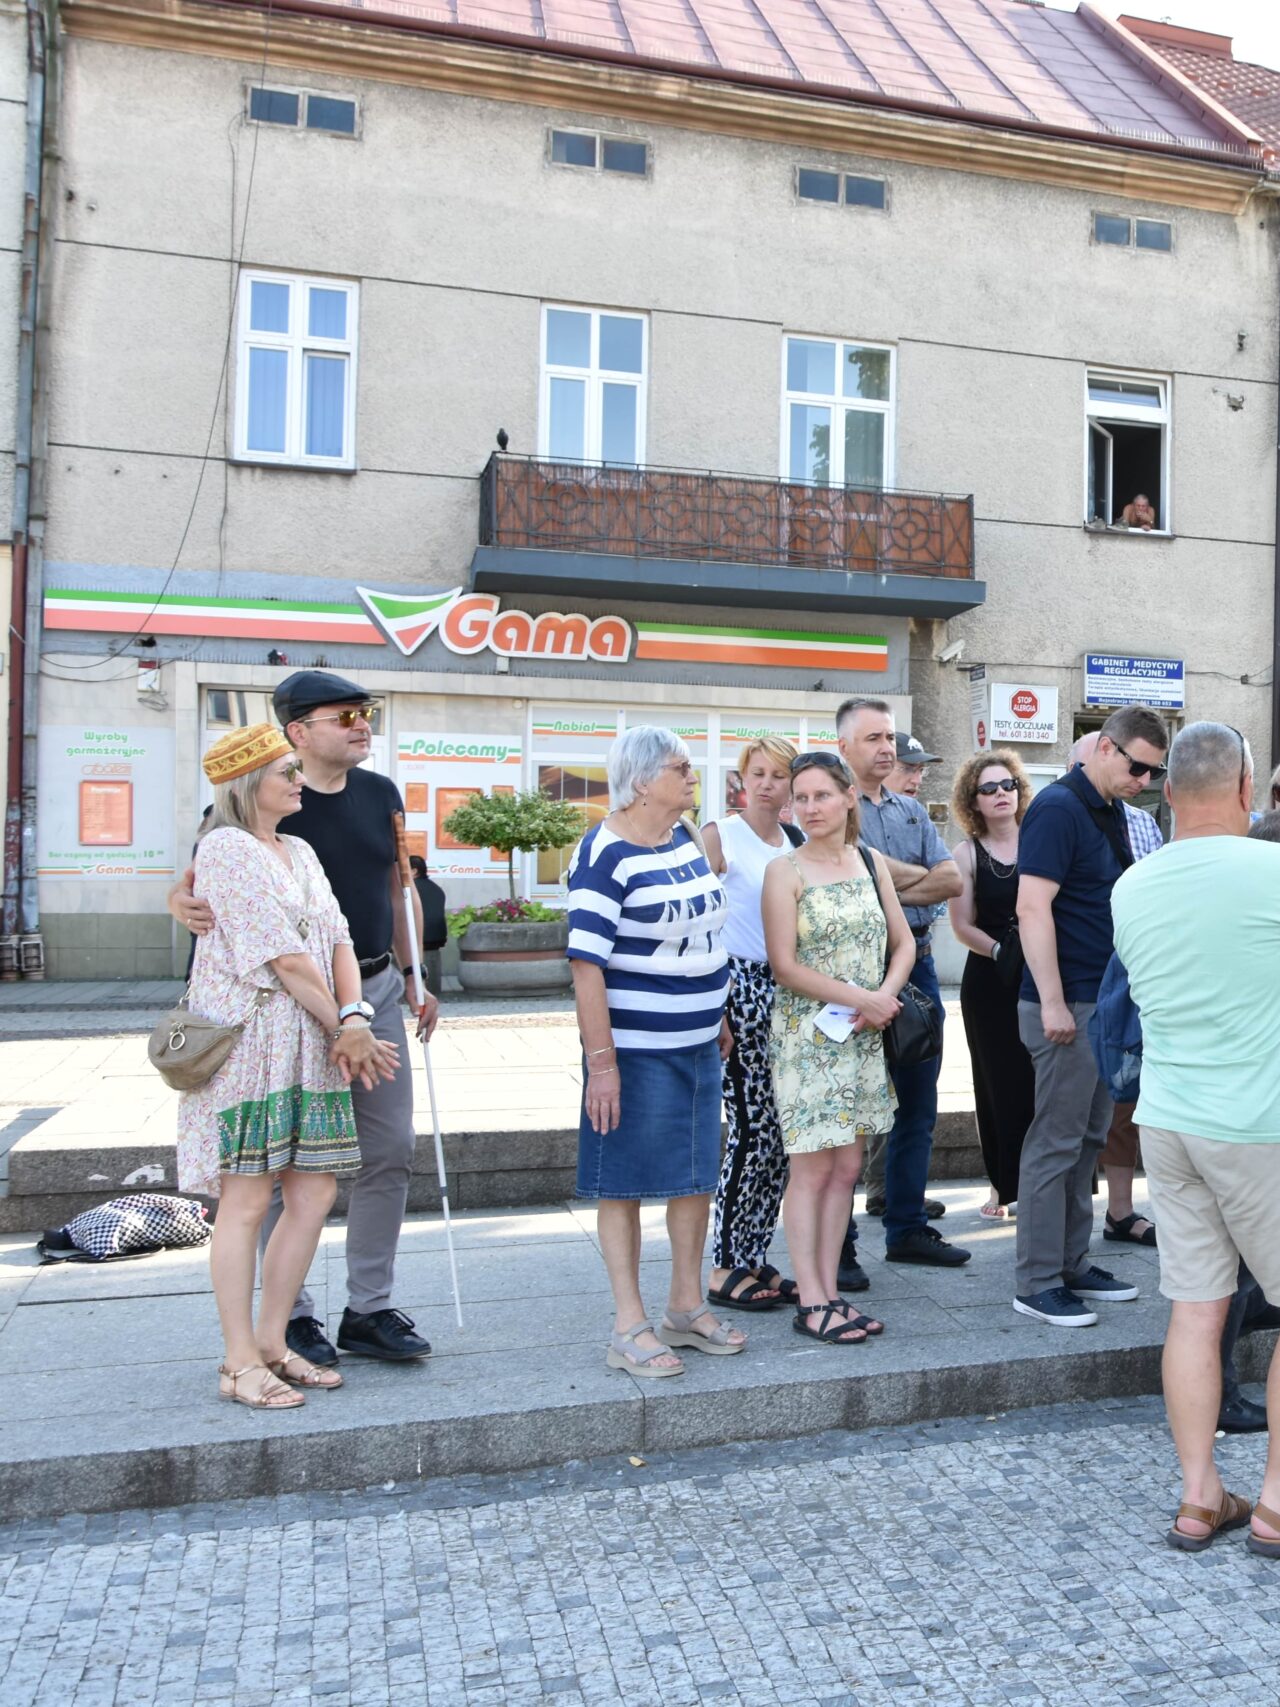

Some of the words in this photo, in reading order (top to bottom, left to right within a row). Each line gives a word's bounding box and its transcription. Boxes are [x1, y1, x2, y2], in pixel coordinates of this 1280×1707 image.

[445, 598, 627, 657] Gama
[1091, 658, 1130, 667] GABINET
[1133, 660, 1179, 670] MEDYCYNY
[1104, 667, 1167, 677] REGULACYJNEJ
[1013, 721, 1054, 731] ODCZULANIE
[84, 731, 128, 743] Wyroby
[411, 739, 508, 761] Polecamy
[96, 864, 134, 875] Gama
[449, 865, 481, 874] Gama
